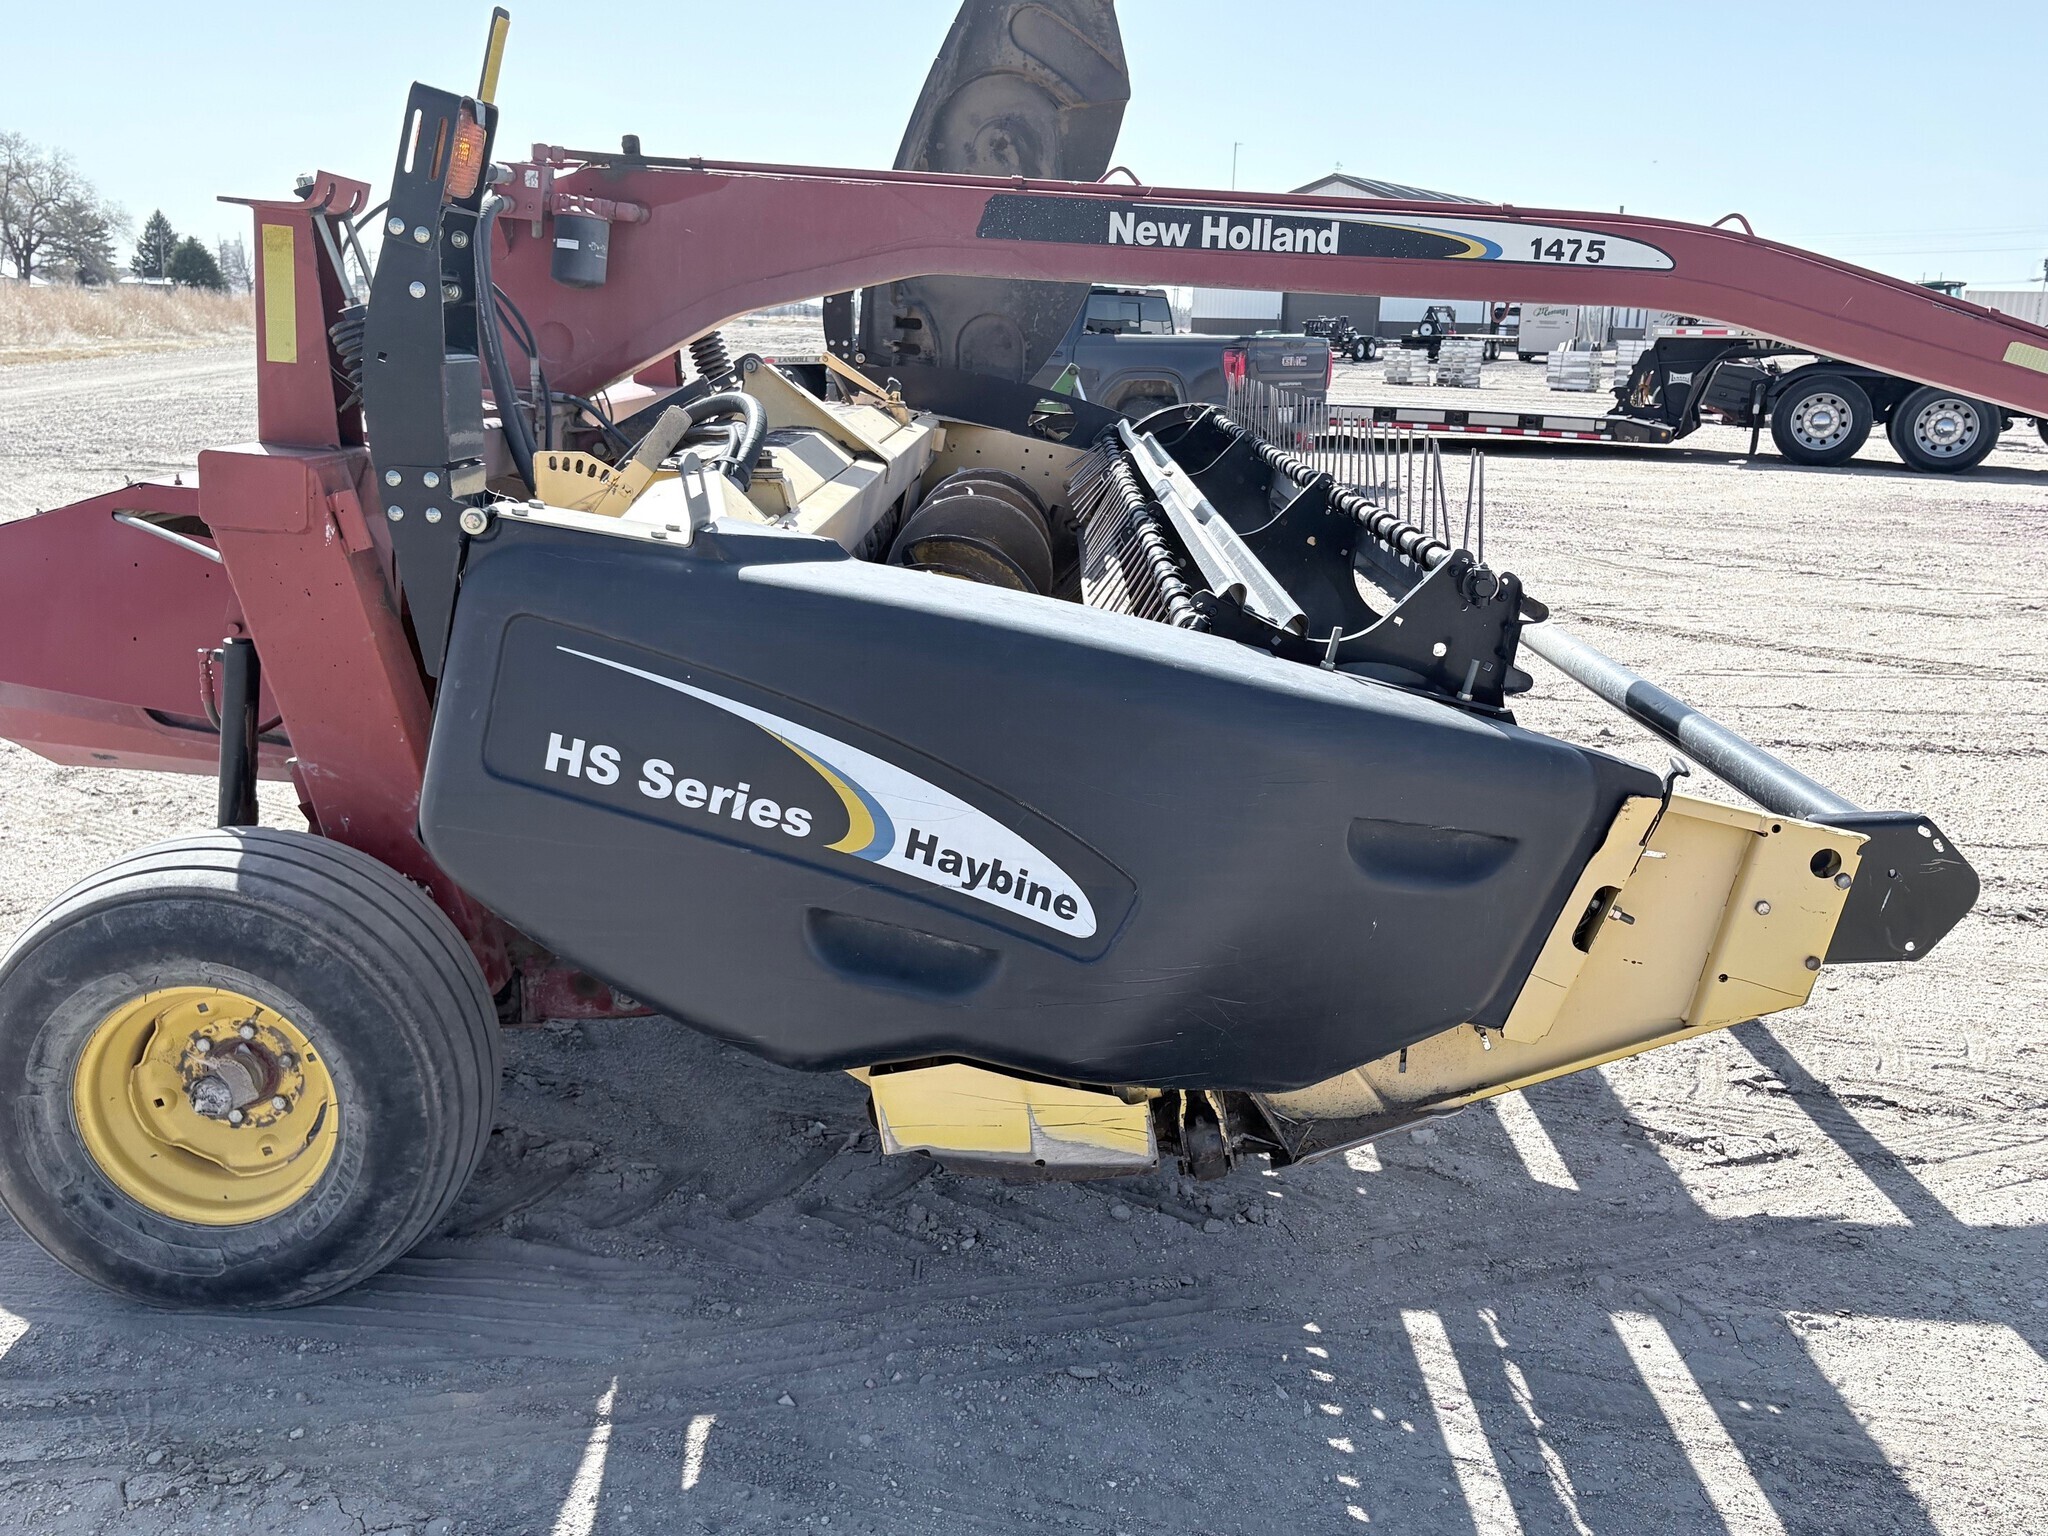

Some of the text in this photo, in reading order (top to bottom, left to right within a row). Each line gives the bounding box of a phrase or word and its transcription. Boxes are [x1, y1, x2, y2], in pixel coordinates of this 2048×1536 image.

[1108, 211, 1340, 255] New Holland
[1530, 236, 1606, 263] 1475
[1281, 355, 1308, 367] GMC
[545, 732, 813, 838] HS Series
[904, 827, 1078, 921] Haybine
